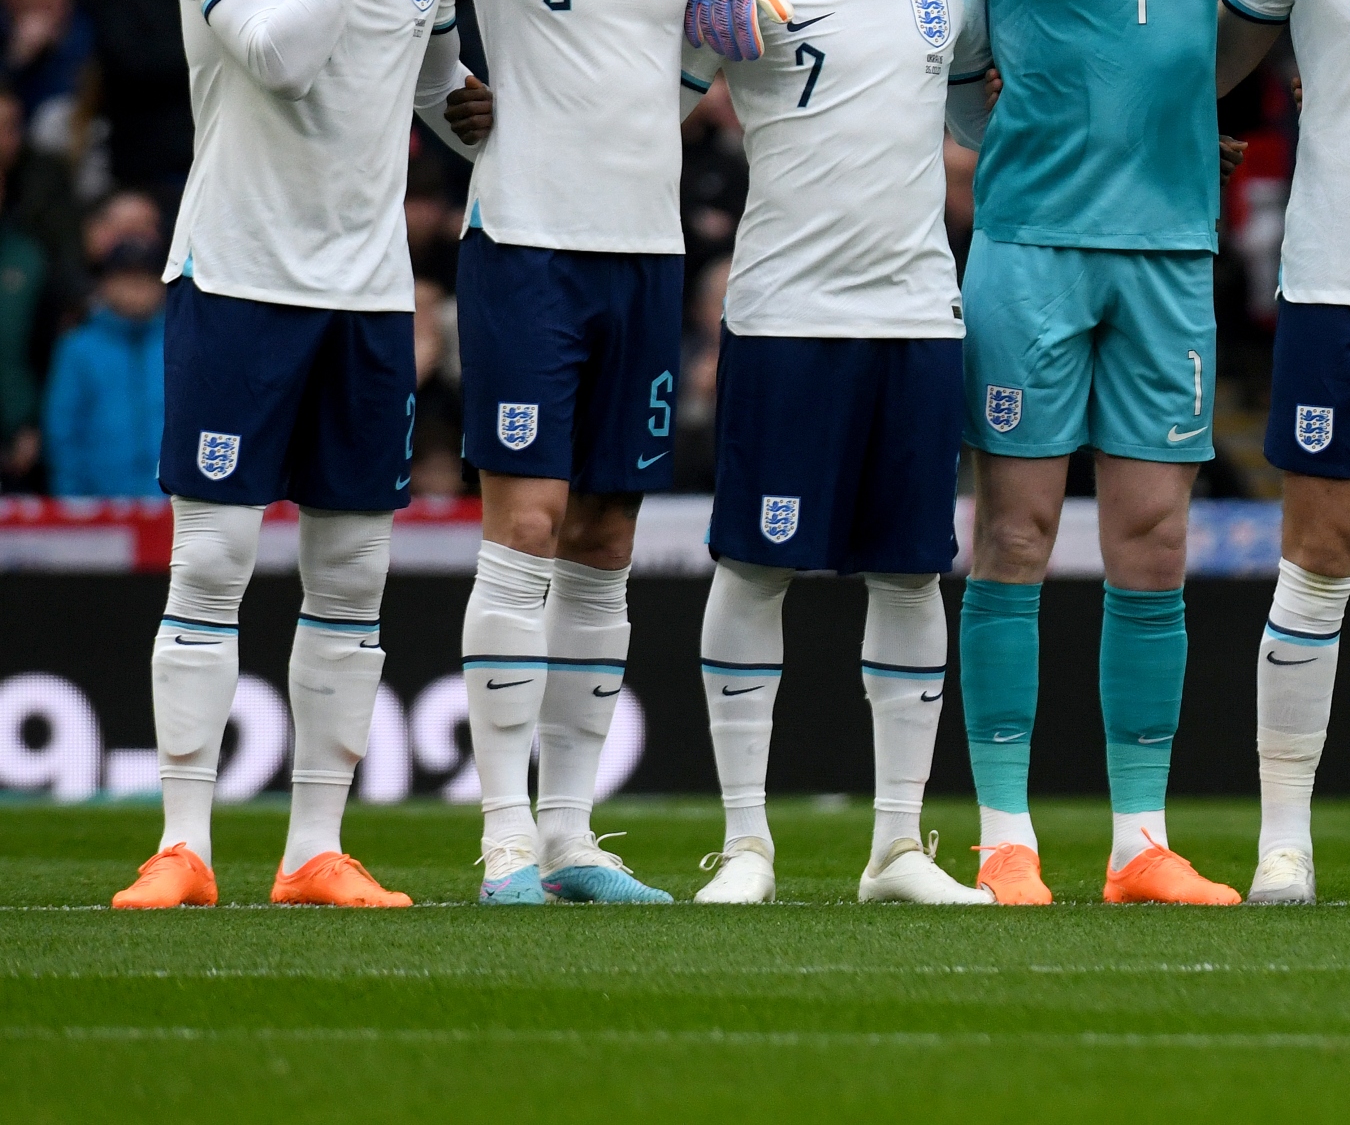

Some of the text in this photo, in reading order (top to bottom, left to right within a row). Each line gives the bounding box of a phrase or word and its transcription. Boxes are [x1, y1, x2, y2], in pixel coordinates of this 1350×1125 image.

[794, 41, 826, 108] 7
[648, 370, 673, 437] 5
[1188, 350, 1202, 416] 1
